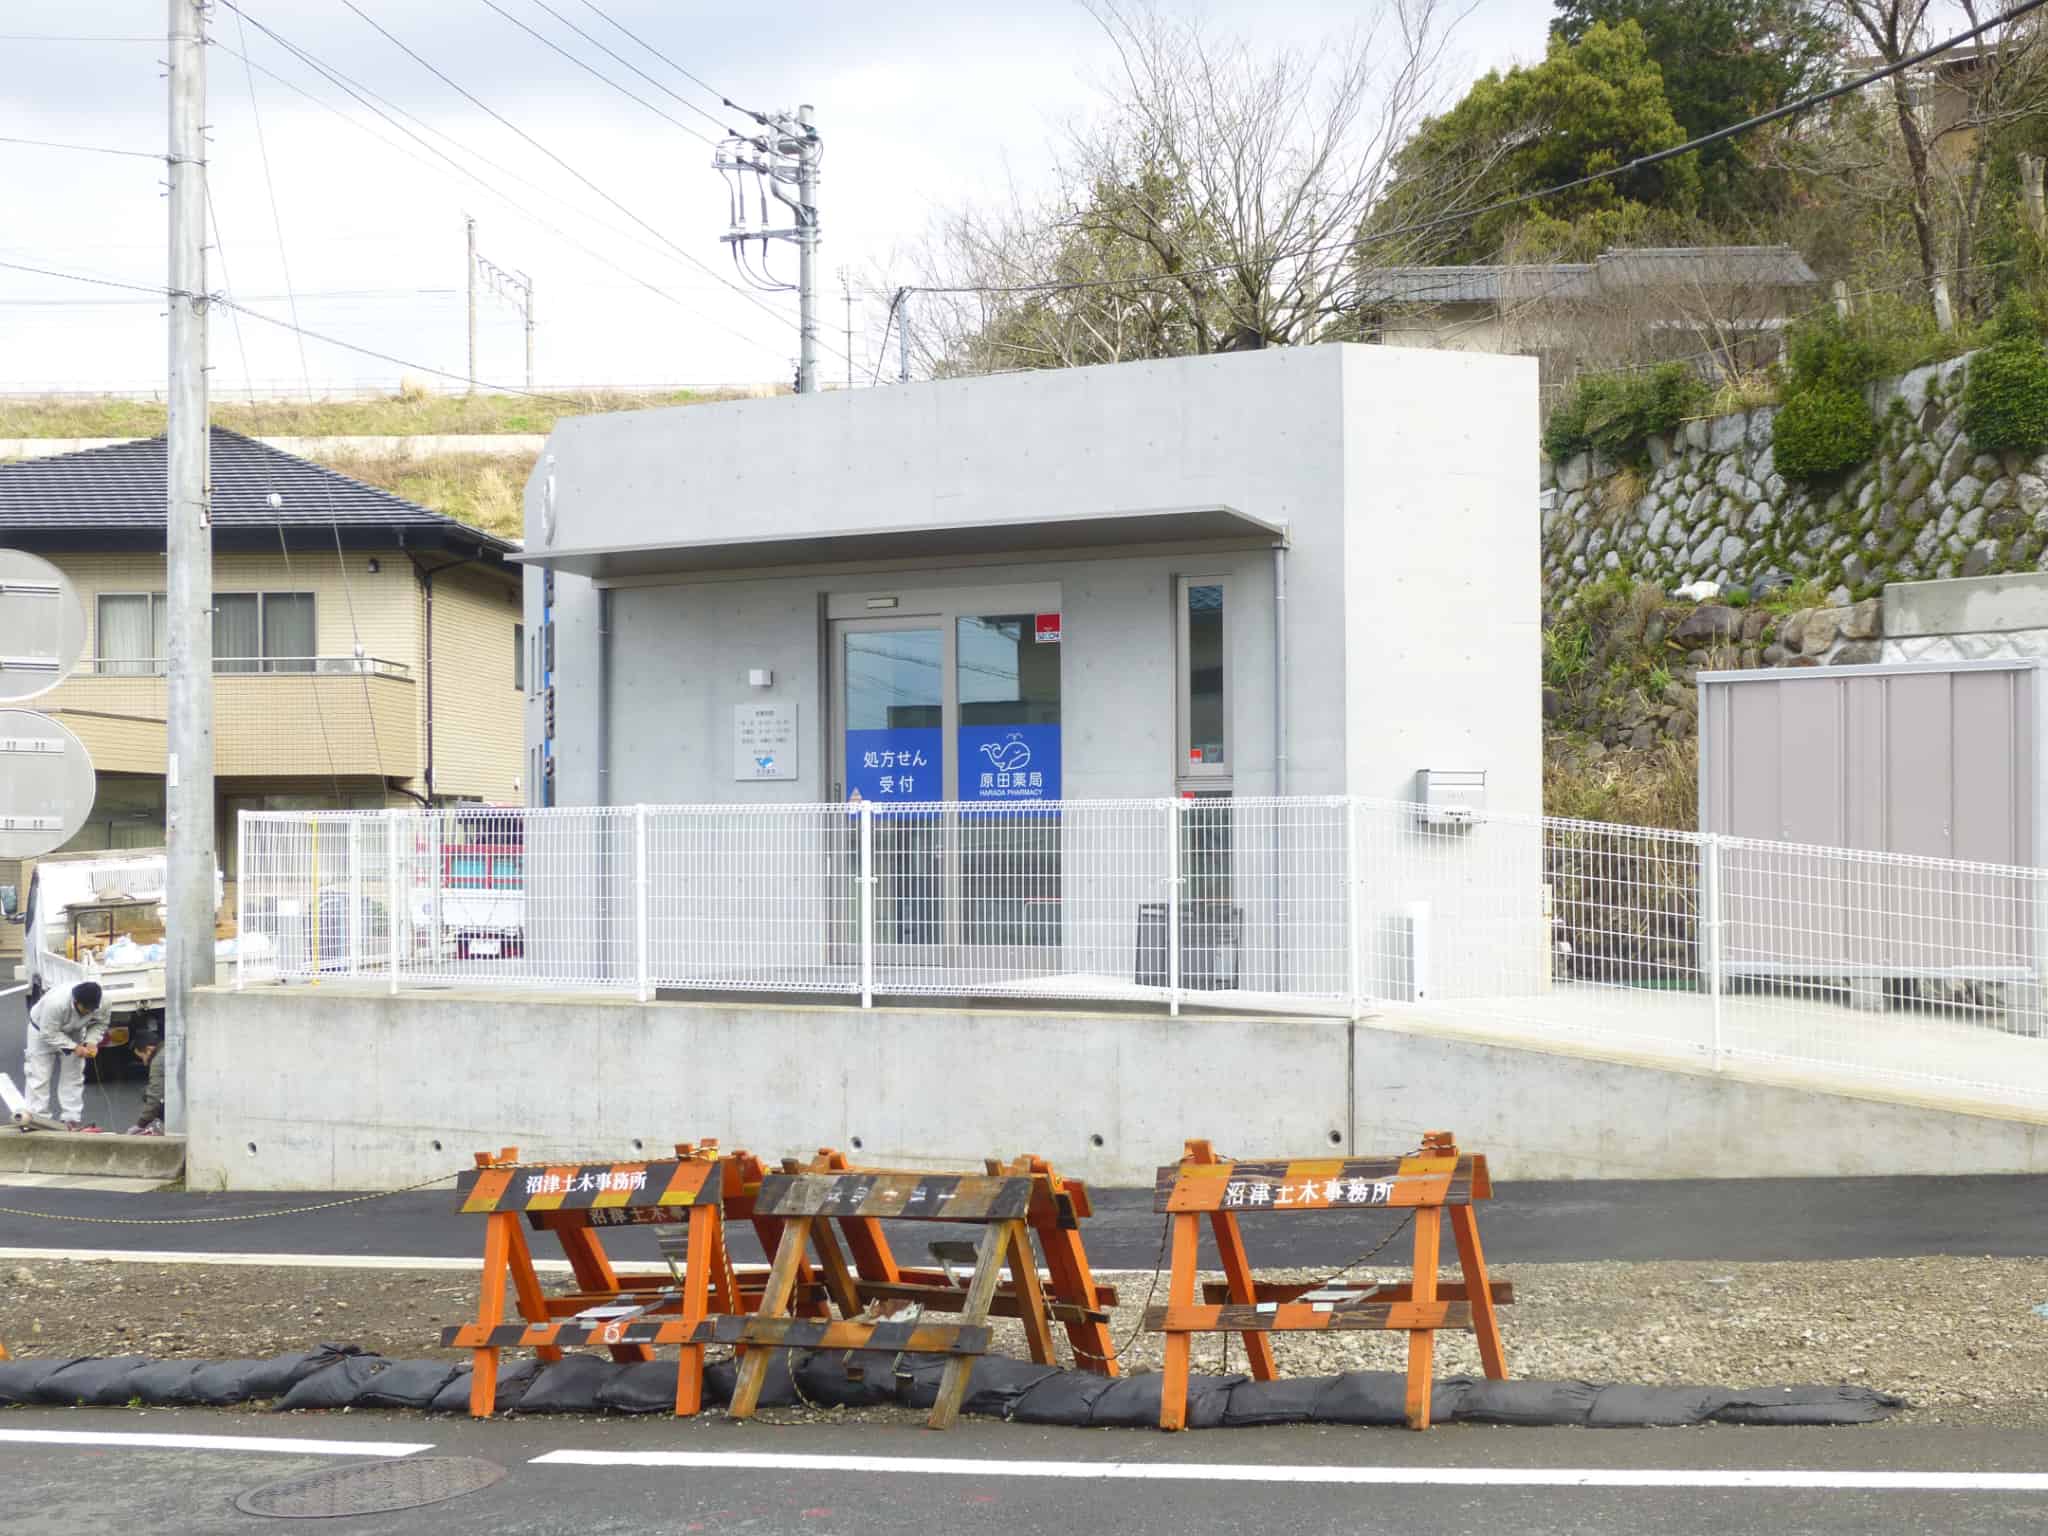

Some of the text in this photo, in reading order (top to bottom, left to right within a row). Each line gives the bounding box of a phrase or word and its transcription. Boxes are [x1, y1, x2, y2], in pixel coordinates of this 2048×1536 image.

[864, 750, 927, 768] 処方せん
[879, 775, 914, 793] 受付
[980, 772, 1042, 788] 原田薬局
[1008, 788, 1042, 796] PHARMACY
[526, 1171, 647, 1195] 沼津土木事務所
[1226, 1177, 1394, 1206] 沼津土木事務所
